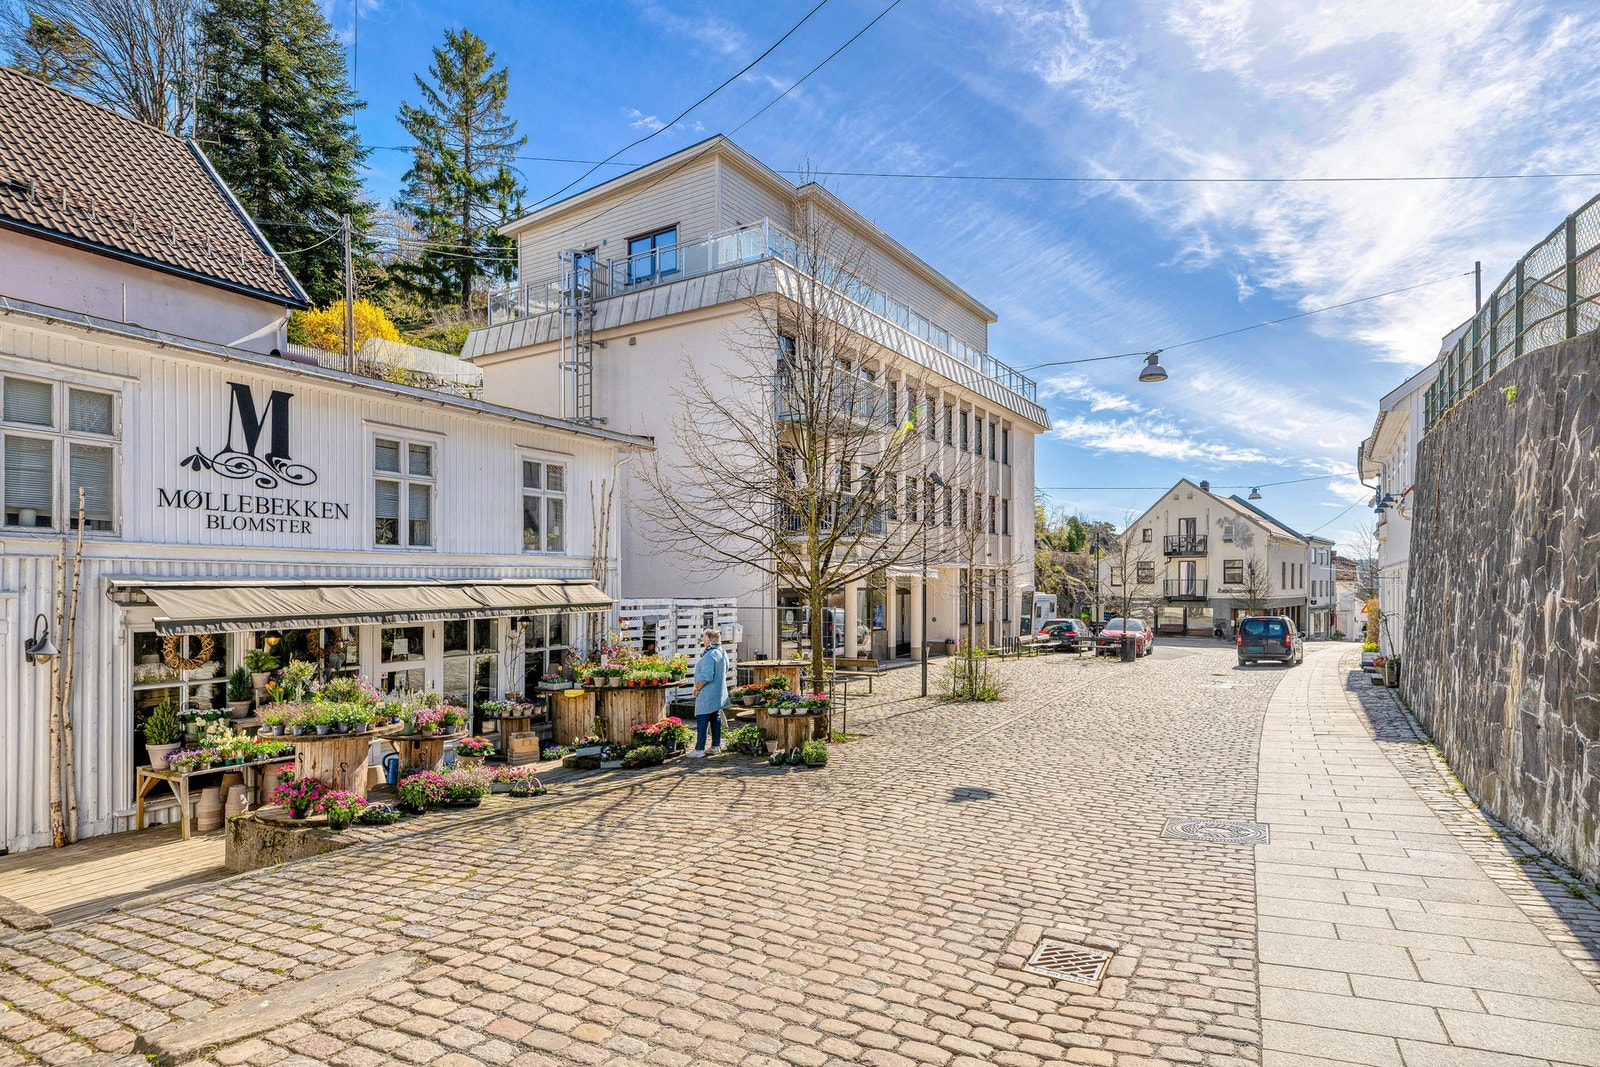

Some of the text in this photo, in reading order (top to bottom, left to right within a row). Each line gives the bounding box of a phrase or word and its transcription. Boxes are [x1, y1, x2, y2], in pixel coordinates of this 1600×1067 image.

[226, 381, 294, 460] M
[157, 488, 350, 520] MØLLEBEKKEN
[206, 514, 312, 534] BLOMSTER
